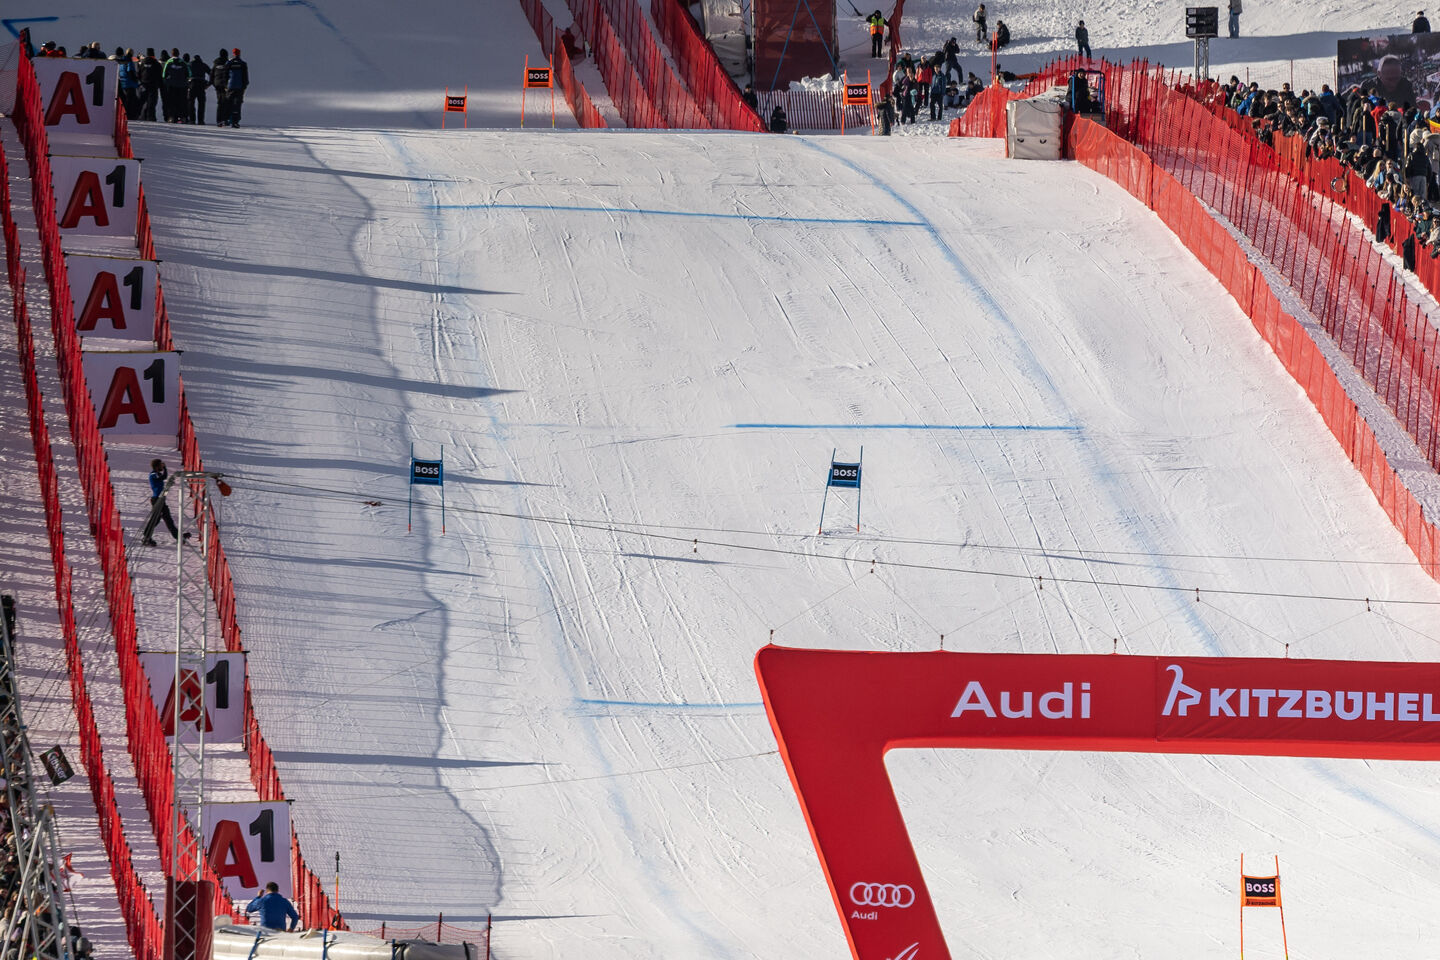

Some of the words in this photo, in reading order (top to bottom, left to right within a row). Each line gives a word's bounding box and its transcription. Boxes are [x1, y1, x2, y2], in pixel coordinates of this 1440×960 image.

[45, 65, 105, 126] A1
[61, 165, 126, 229] A1
[76, 266, 144, 332] A1
[97, 358, 165, 430] A1
[415, 466, 439, 475] BOSS
[833, 469, 857, 477] BOSS
[161, 660, 229, 737] A1
[950, 681, 1091, 719] Audi
[207, 809, 275, 889] A1
[851, 911, 878, 920] Audi
[1246, 883, 1275, 893] BOSS
